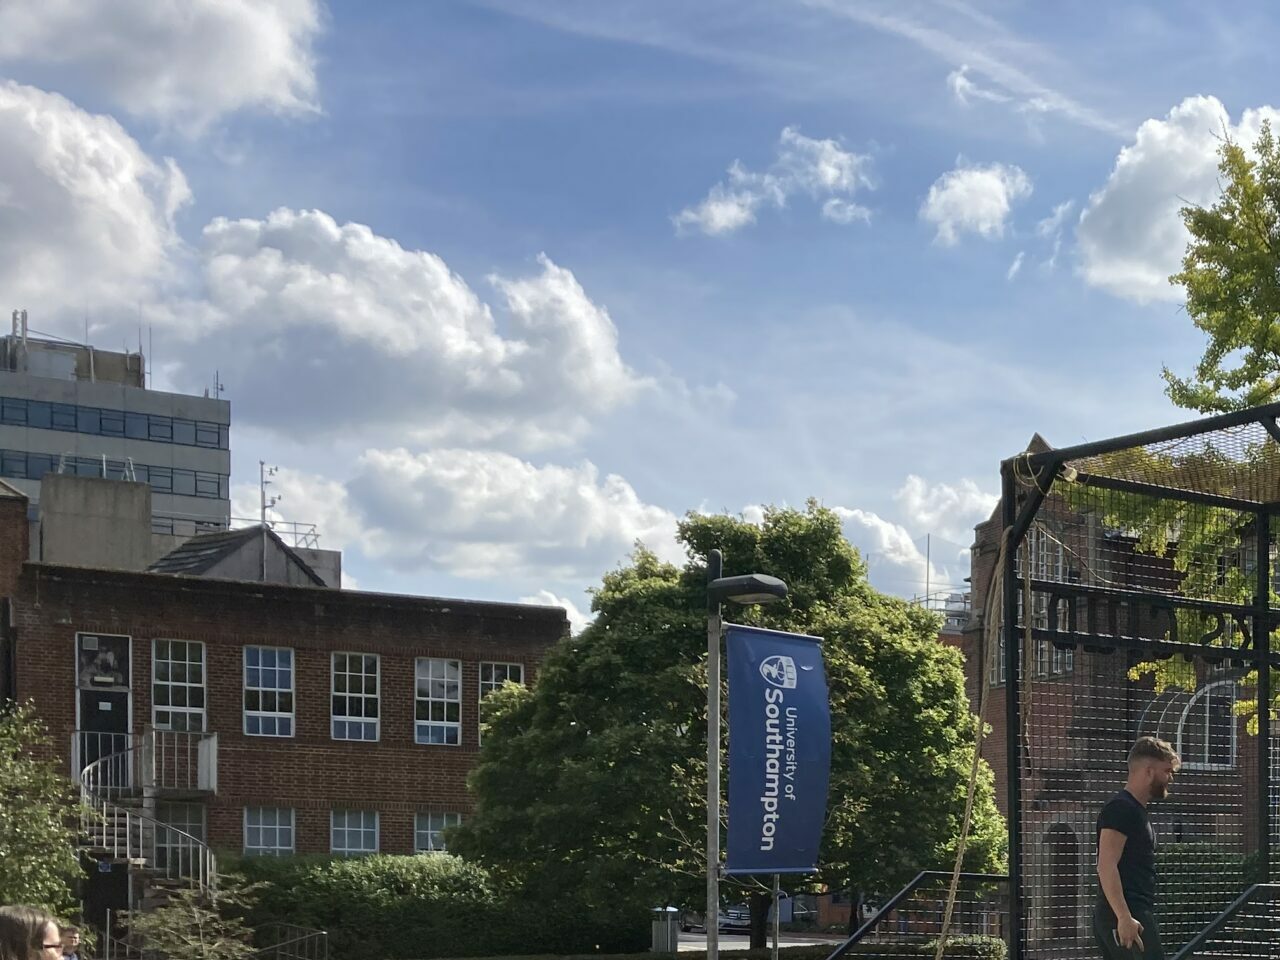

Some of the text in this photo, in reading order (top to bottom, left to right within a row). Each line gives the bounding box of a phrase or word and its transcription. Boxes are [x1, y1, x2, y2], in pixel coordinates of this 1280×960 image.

[760, 688, 784, 851] Southampton
[783, 707, 797, 801] University of
